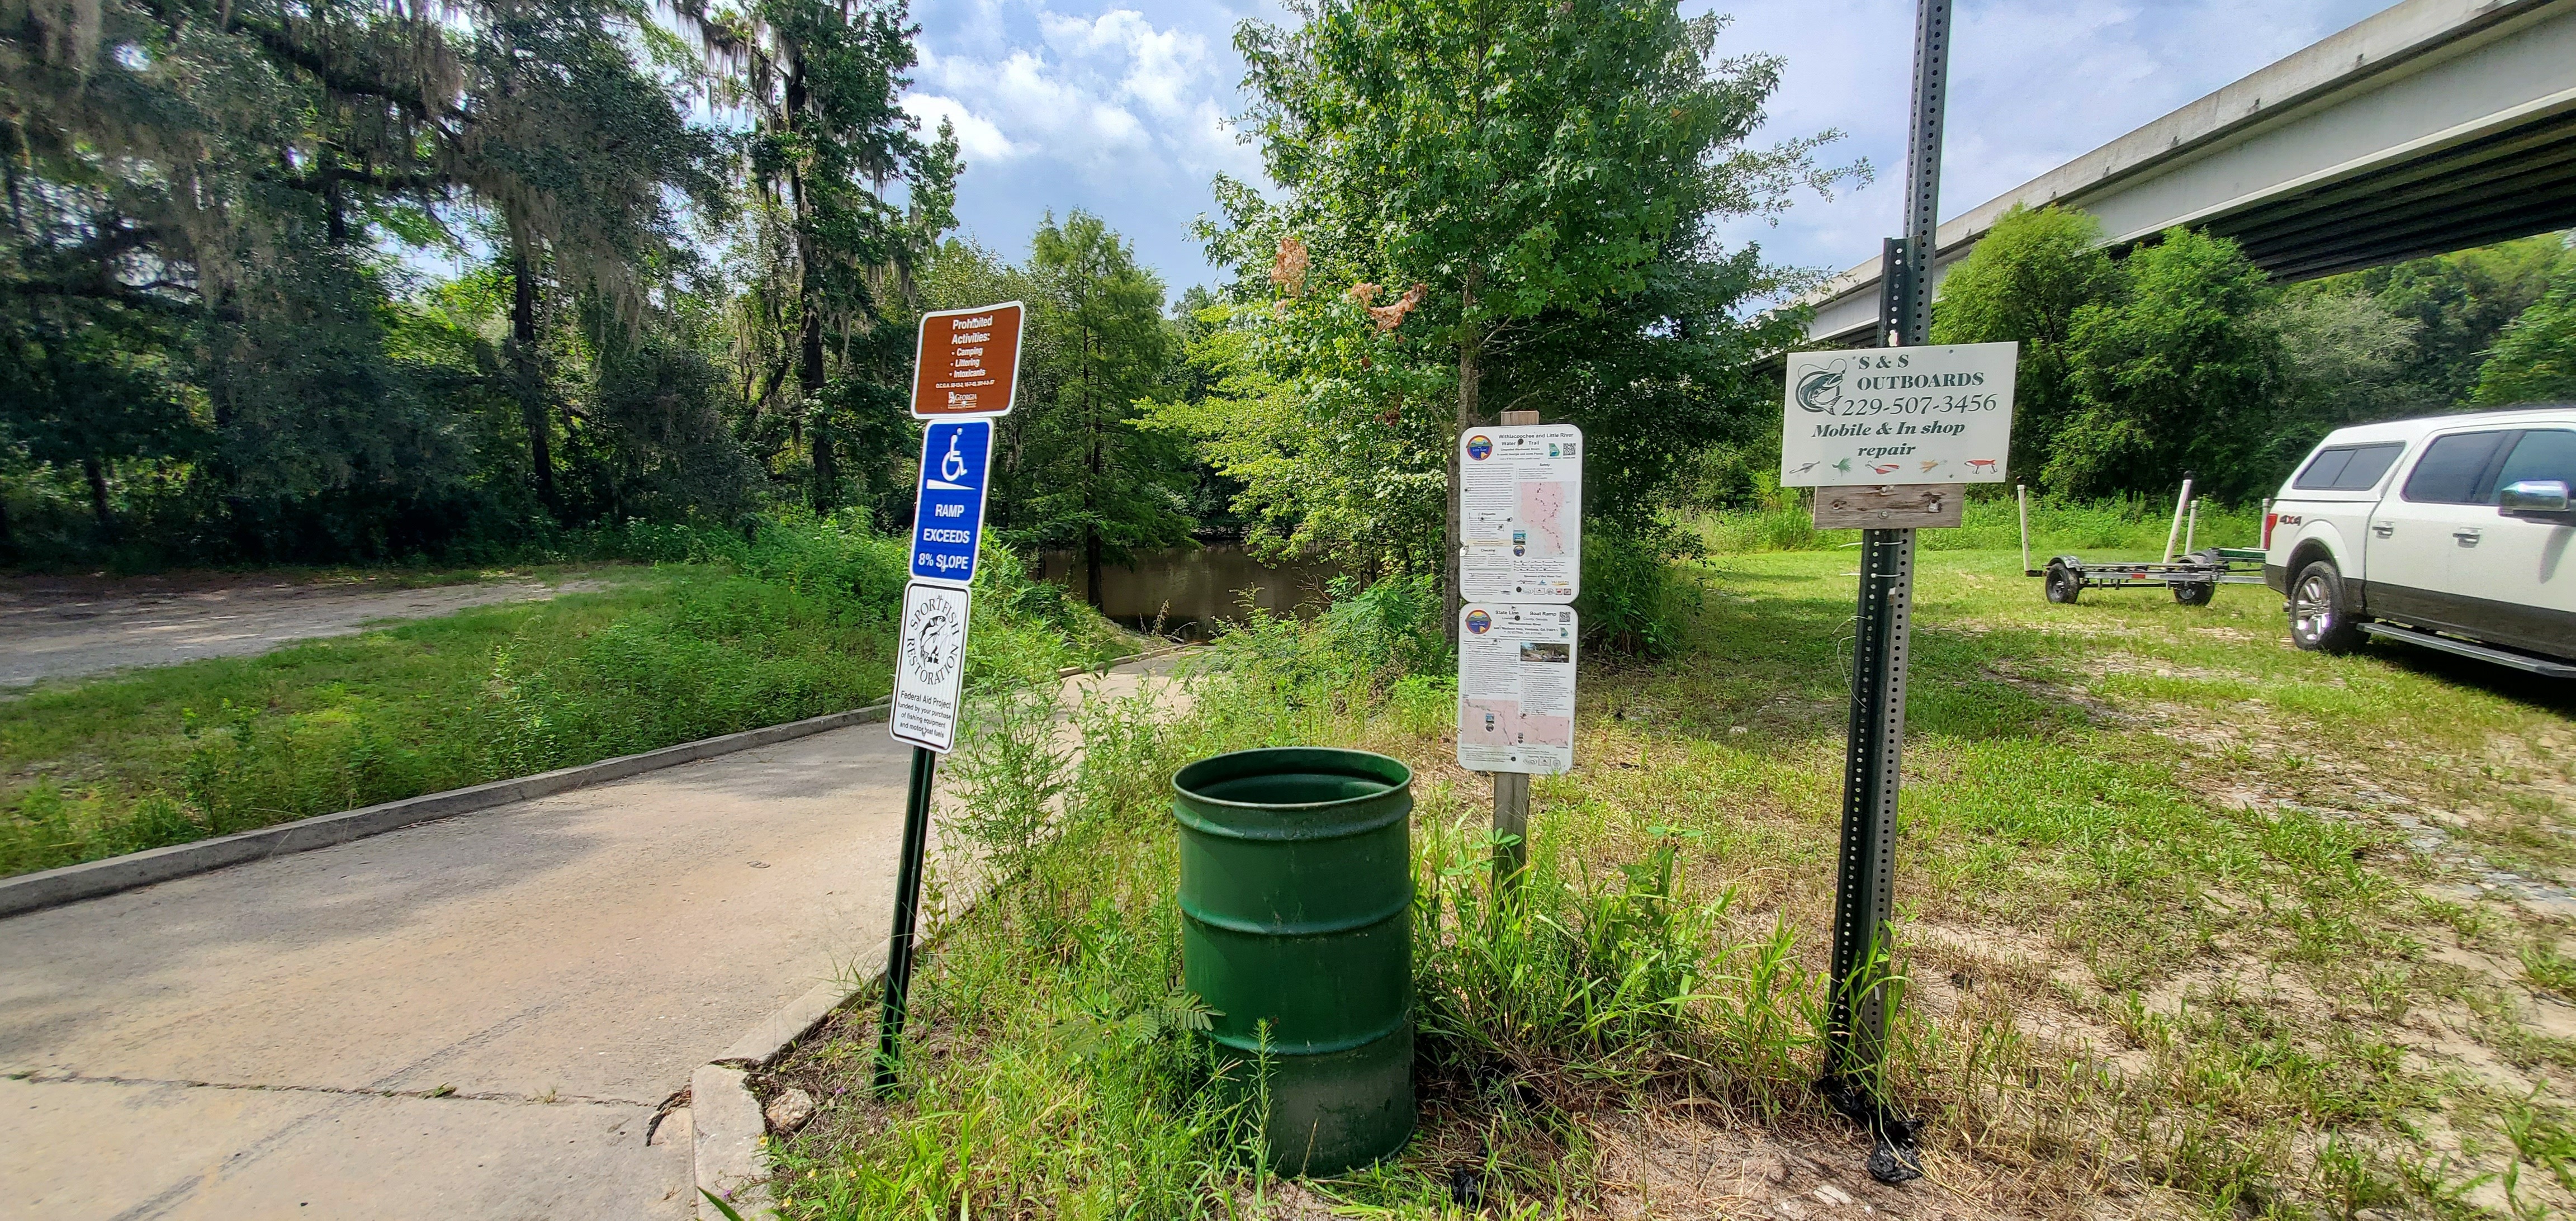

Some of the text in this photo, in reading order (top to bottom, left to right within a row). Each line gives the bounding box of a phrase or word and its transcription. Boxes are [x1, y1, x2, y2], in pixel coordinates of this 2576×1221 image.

[951, 332, 991, 344] Activities:
[956, 347, 983, 357] Camping
[955, 358, 980, 367] Littering
[1858, 354, 1909, 370] S & S
[954, 369, 986, 378] Intoxicants
[1857, 372, 1984, 391] OUTBOARDS
[1841, 393, 1998, 416] 229-507-3456
[1811, 420, 1965, 438] Mobile & In shop
[1858, 443, 1916, 459] repair
[935, 504, 964, 518] RAMP
[923, 528, 970, 543] EXCEEDS
[918, 553, 969, 569] 8% SLOPE
[907, 638, 959, 685] RESTORATION
[901, 690, 951, 709] Federal Aid Project
[898, 701, 914, 710] funded
[915, 705, 920, 713] by
[932, 711, 951, 720] purchase
[907, 713, 922, 723] fishing
[924, 718, 946, 728] equipment
[934, 729, 944, 738] fuels
